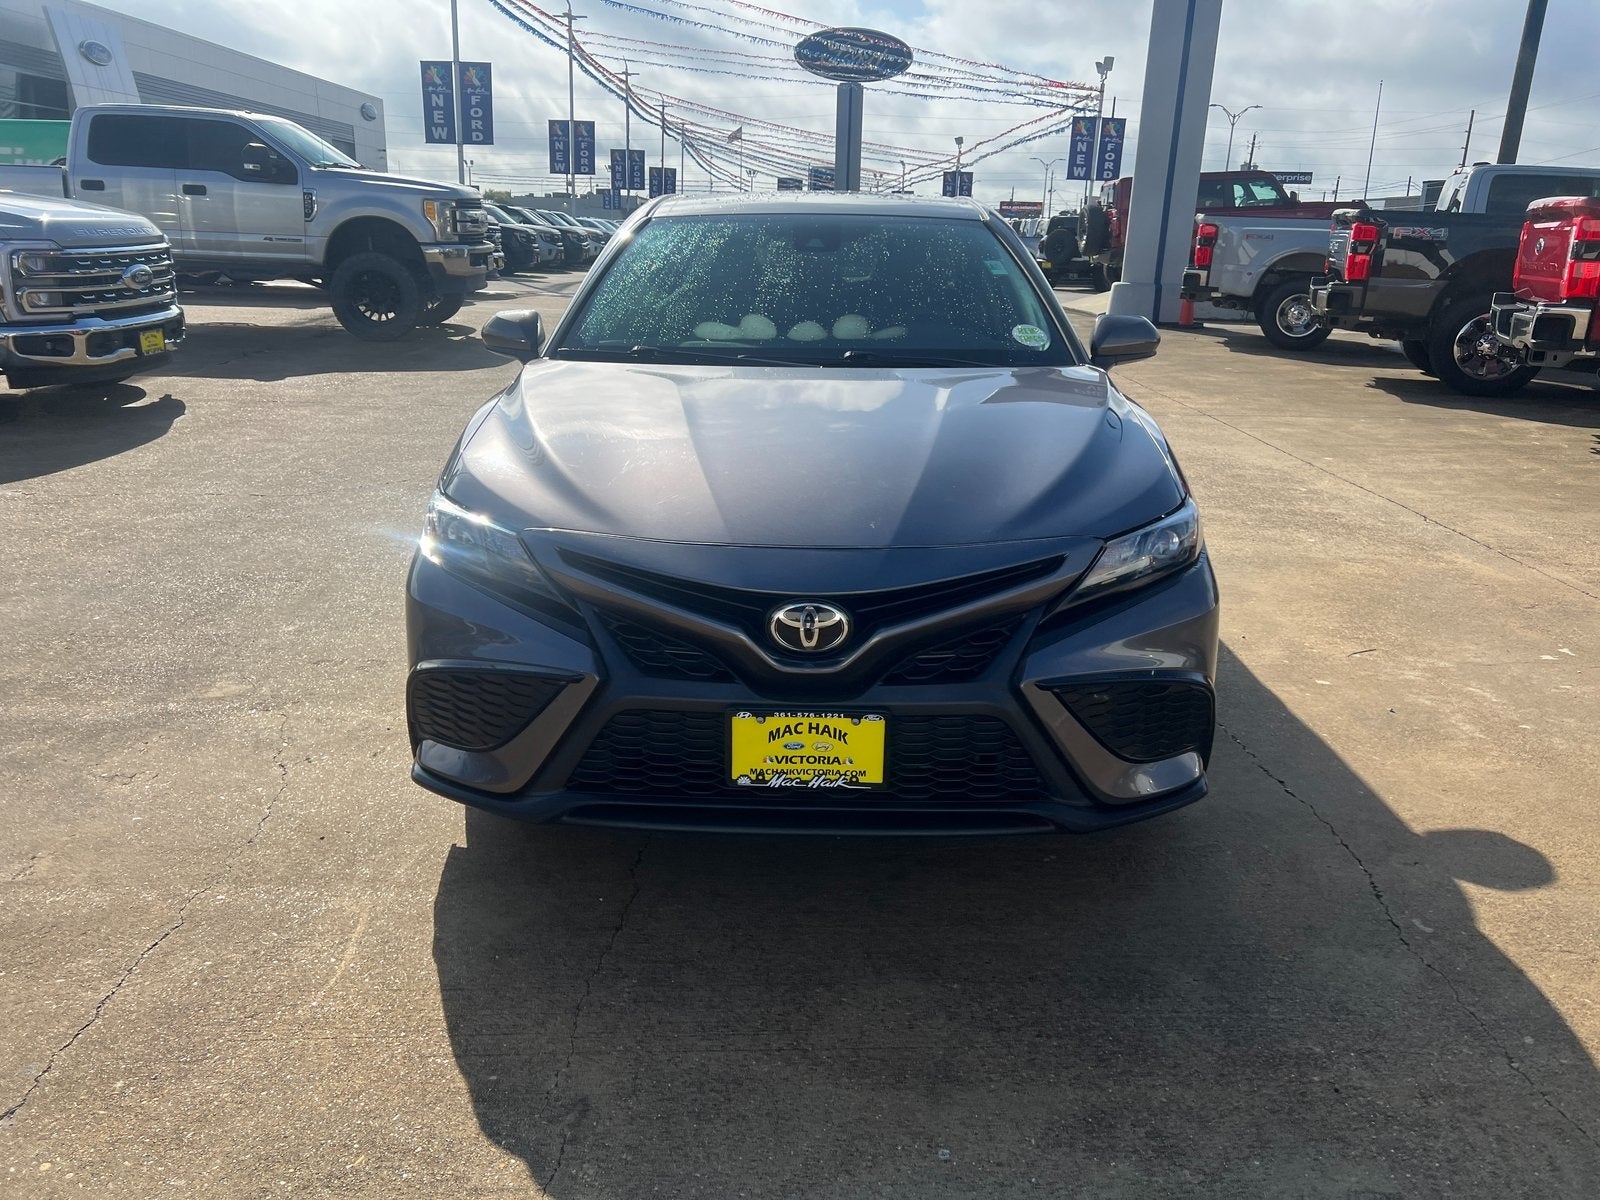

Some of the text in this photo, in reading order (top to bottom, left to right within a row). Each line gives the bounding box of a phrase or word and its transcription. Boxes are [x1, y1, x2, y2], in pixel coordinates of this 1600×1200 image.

[431, 93, 448, 140] NEW
[470, 95, 484, 142] FORD
[554, 141, 566, 172] NEW
[580, 142, 589, 173] FORD
[1073, 142, 1087, 177] NEW
[1103, 143, 1116, 179] FORD
[614, 165, 624, 188] NEW
[1392, 226, 1449, 240] FX4
[773, 711, 844, 719] 361-576-1221
[767, 722, 849, 745] MAC HAIK
[774, 755, 842, 766] VICTORIA
[767, 773, 848, 790] Mac Haik
